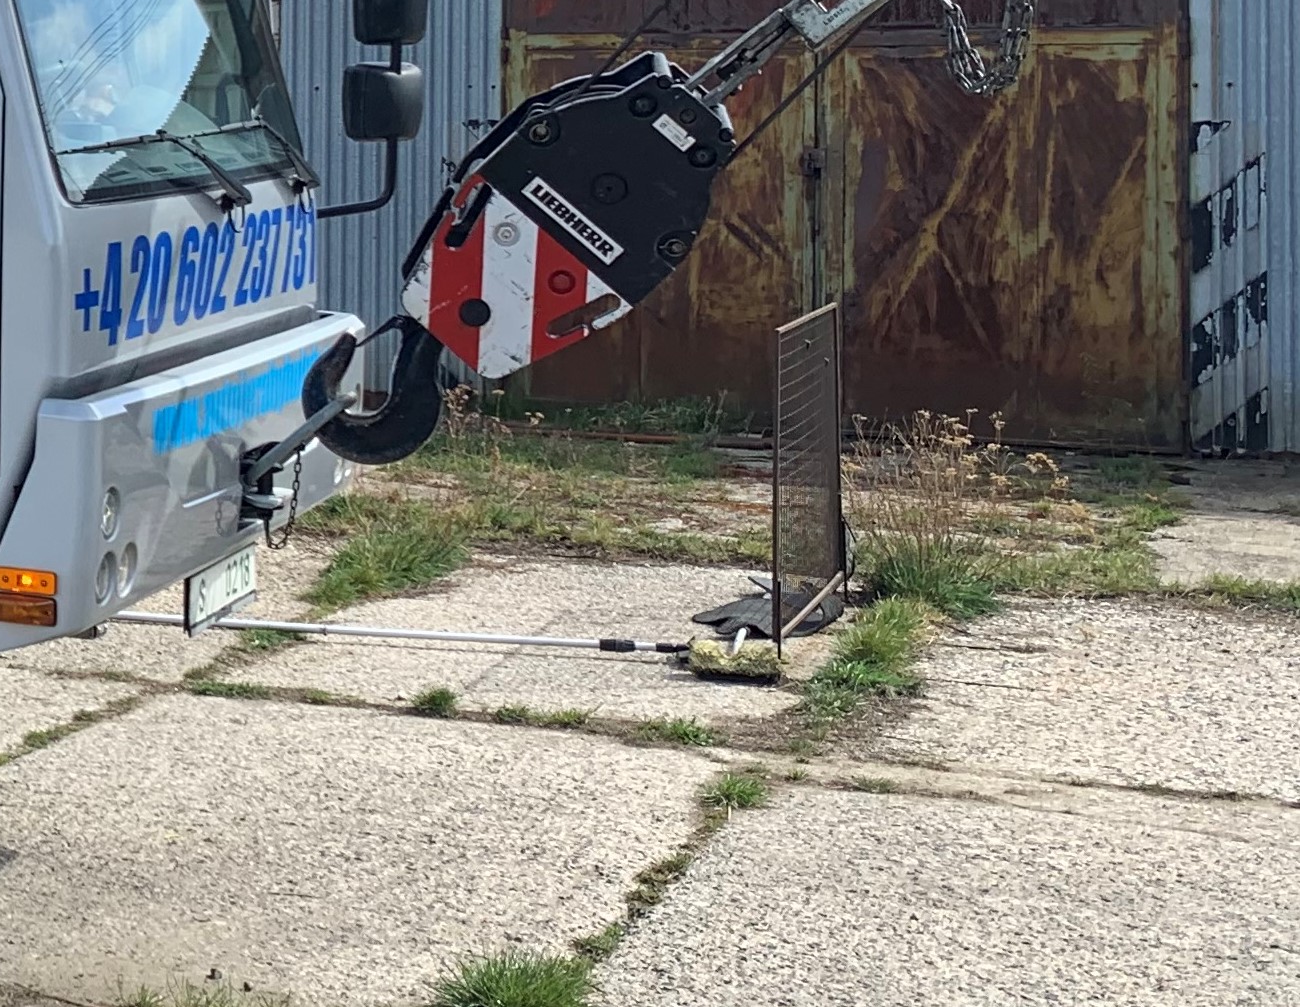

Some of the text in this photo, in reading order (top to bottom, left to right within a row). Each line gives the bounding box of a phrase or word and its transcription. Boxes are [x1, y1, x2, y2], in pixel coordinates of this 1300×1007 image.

[74, 195, 315, 346] +420 602 237 731
[531, 183, 615, 258] LIEBHERR
